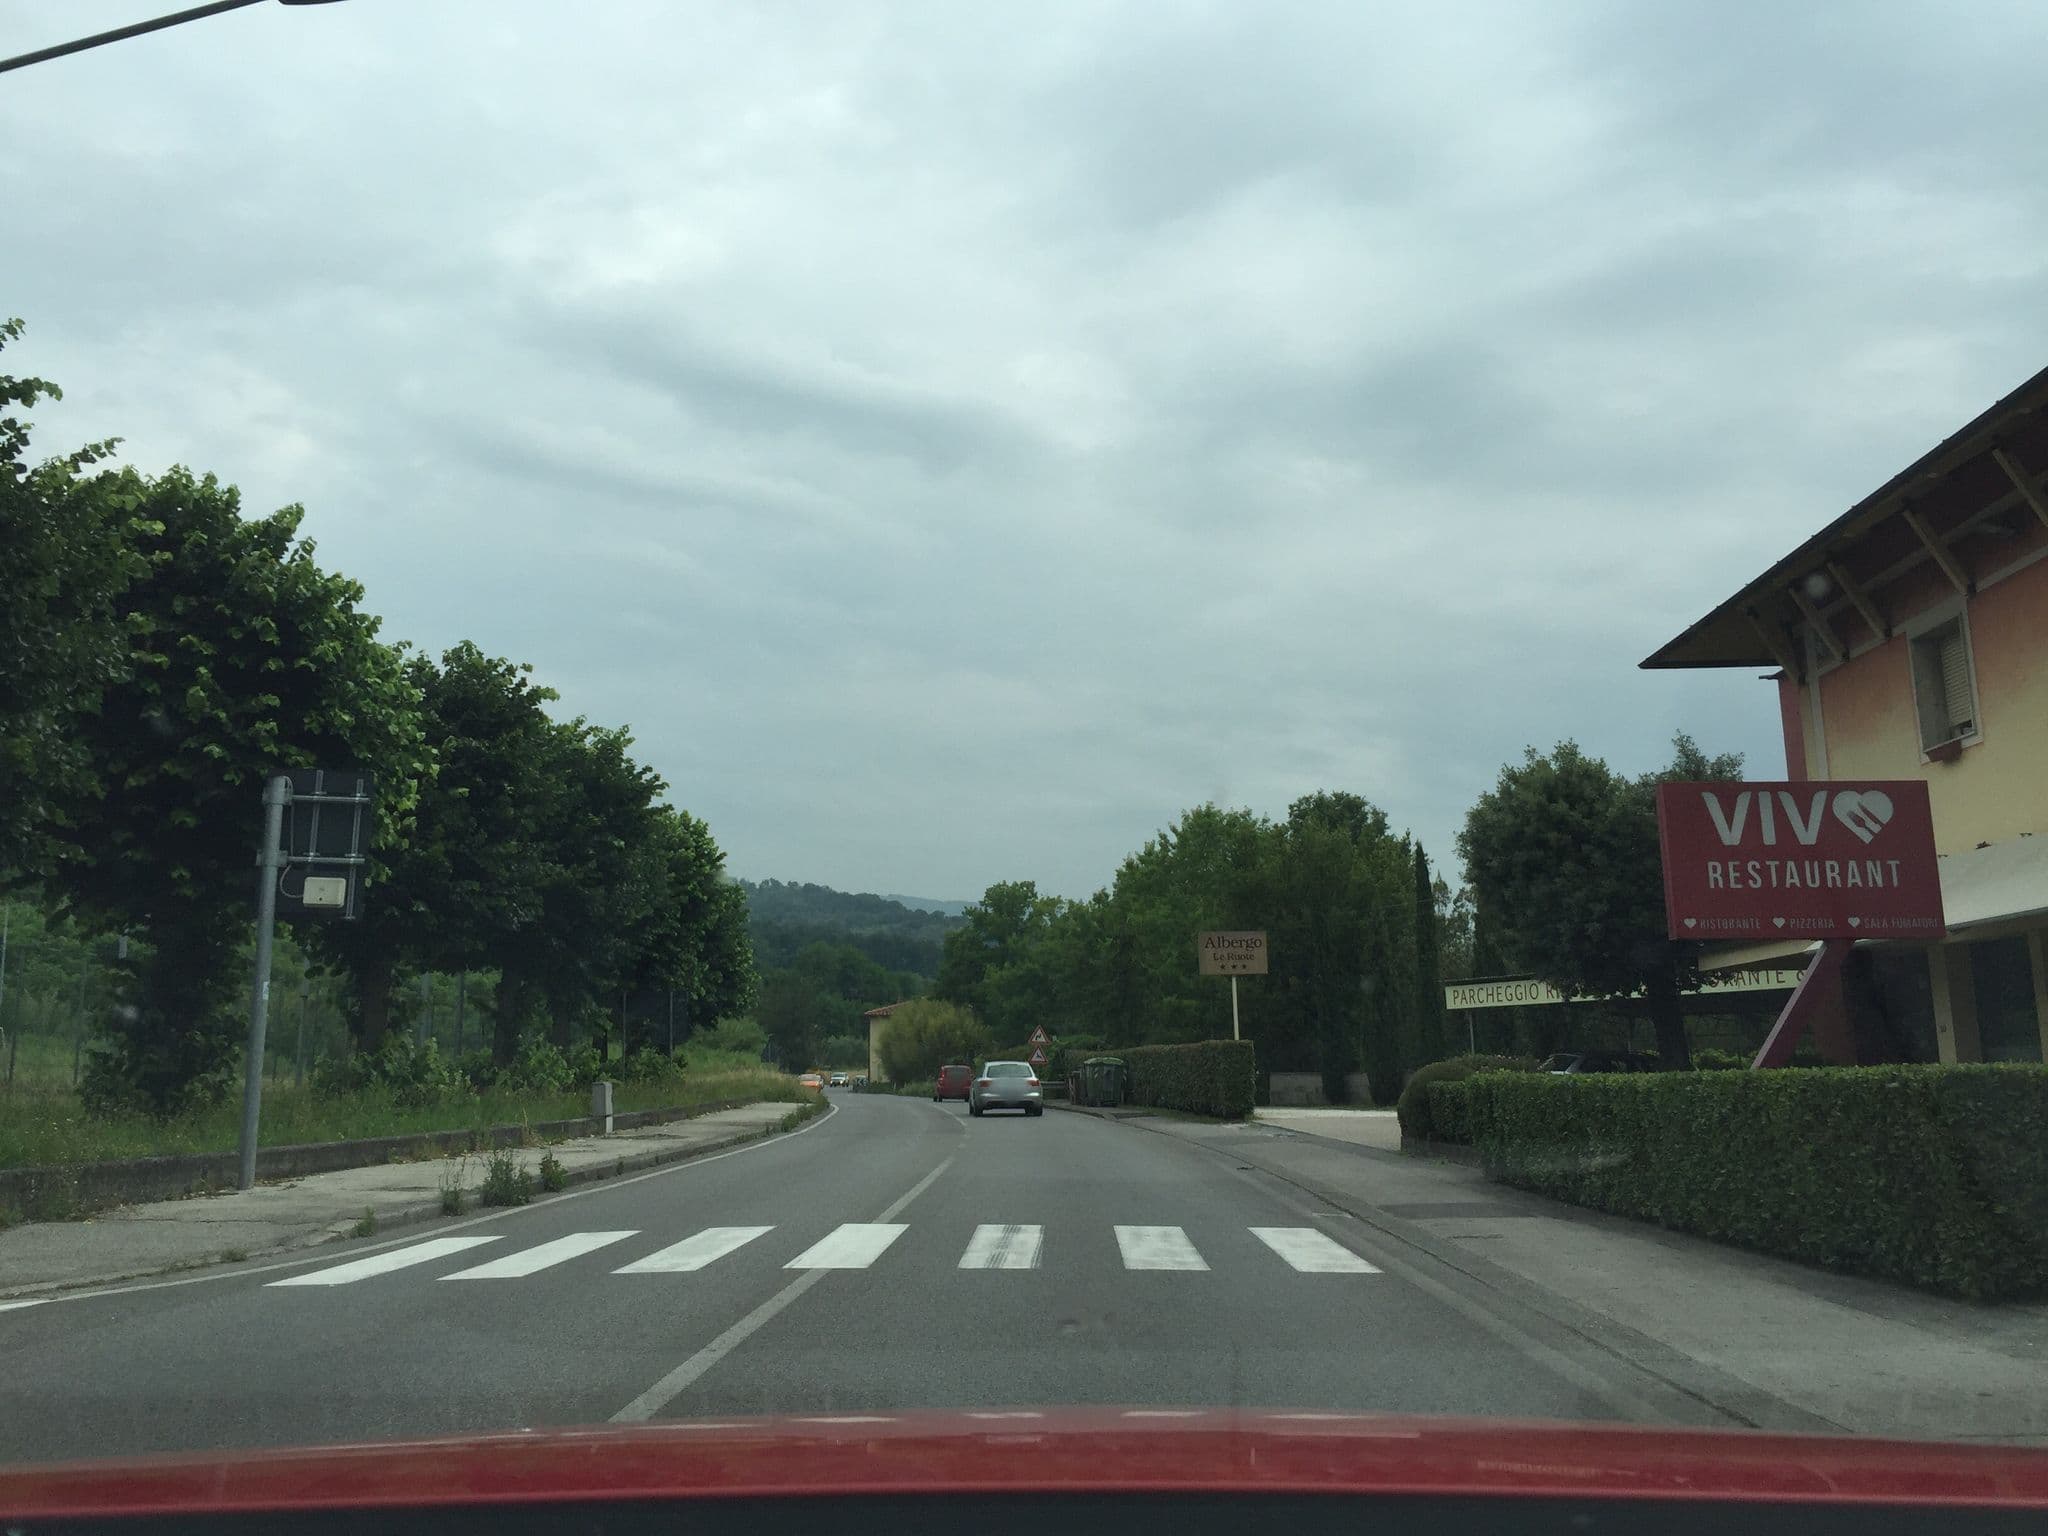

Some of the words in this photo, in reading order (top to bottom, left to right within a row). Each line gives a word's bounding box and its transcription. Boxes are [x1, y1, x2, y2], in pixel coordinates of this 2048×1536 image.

[1707, 860, 1901, 889] RESTAURANT
[1700, 918, 1761, 929] RISTORANTE
[1789, 918, 1835, 929] PIZZERIA
[1205, 936, 1262, 951] Albergo
[1213, 952, 1225, 961] Le
[1453, 982, 1540, 1005] PARCHEGGIO
